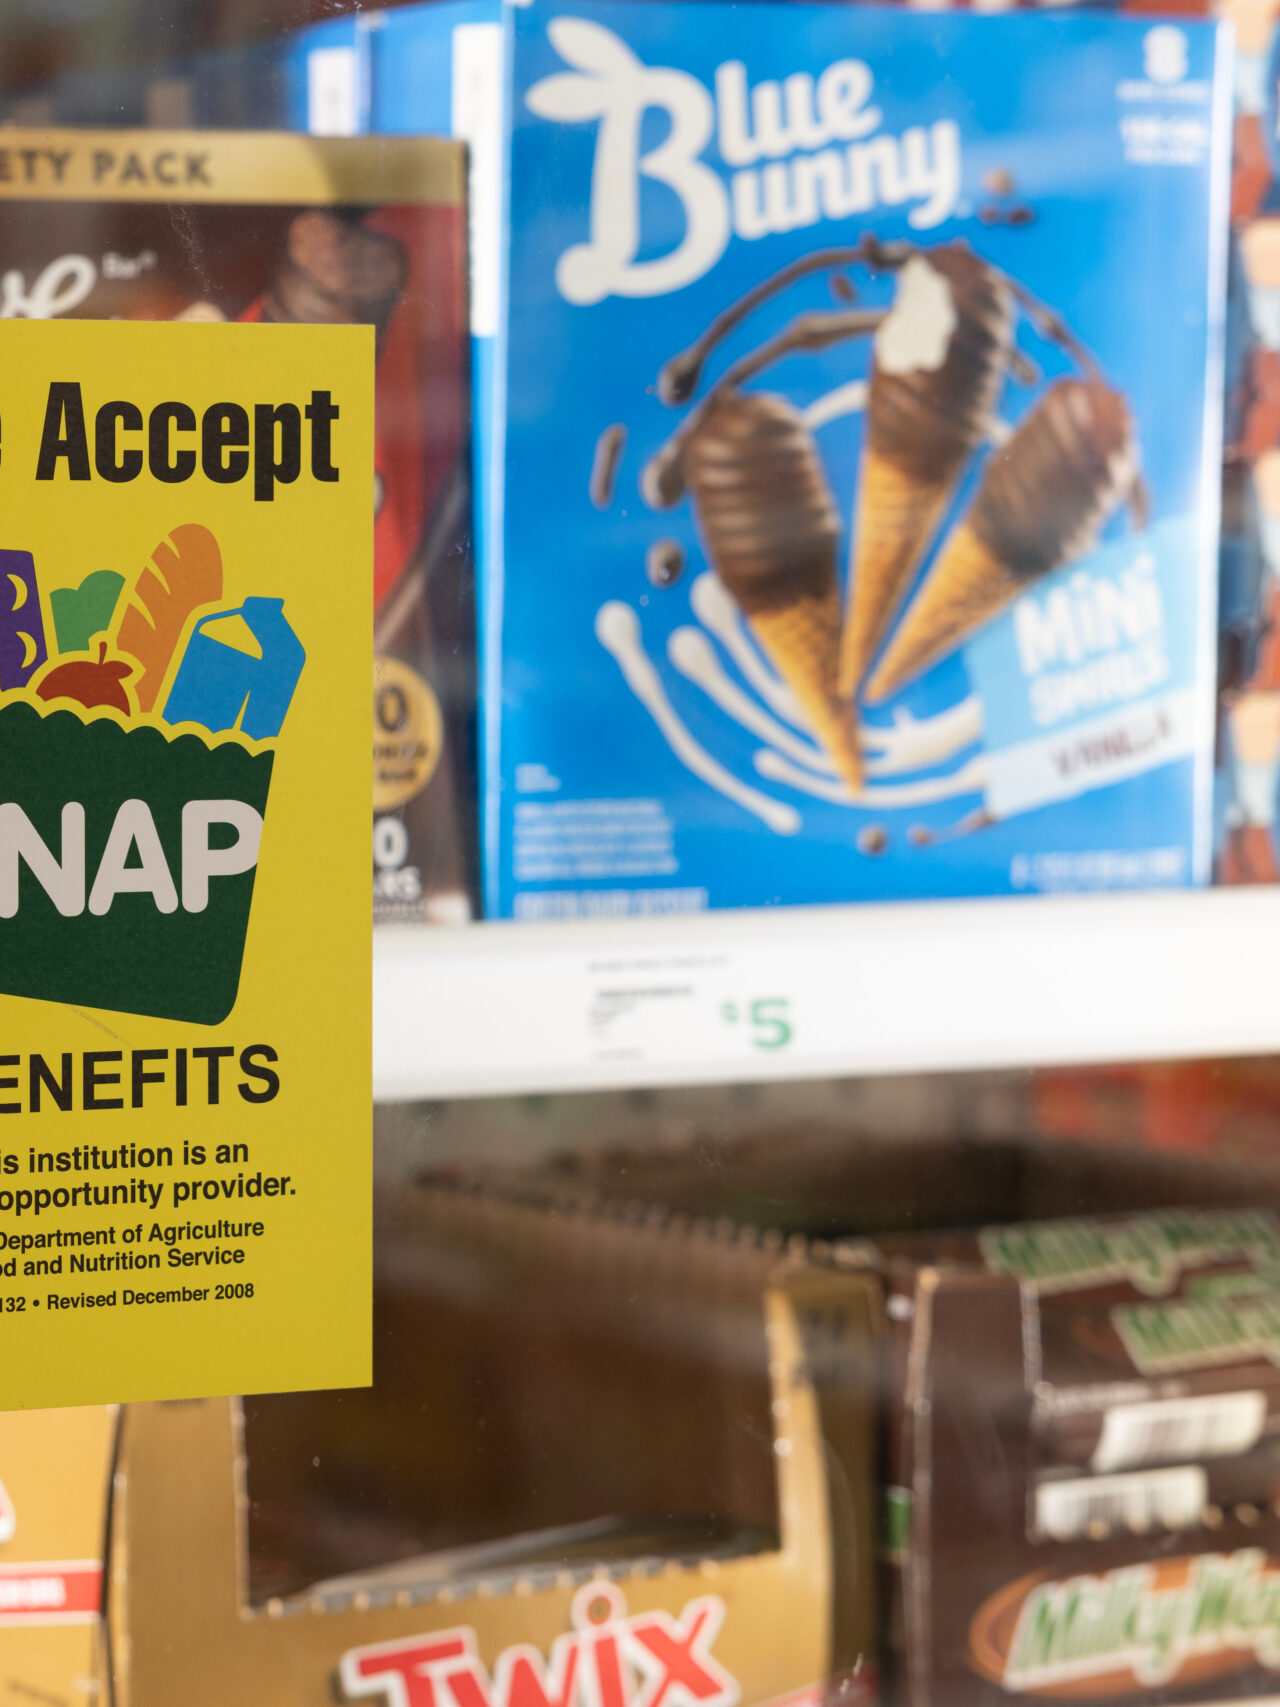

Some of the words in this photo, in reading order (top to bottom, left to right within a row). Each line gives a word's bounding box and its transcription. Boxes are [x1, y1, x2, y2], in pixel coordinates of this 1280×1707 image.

[92, 149, 212, 187] PACK
[35, 381, 340, 502] Accept
[29, 1142, 173, 1174] institution
[183, 1140, 207, 1166] is
[215, 1143, 249, 1164] an
[173, 1172, 296, 1208] provider.
[121, 1224, 143, 1244] of
[148, 1219, 265, 1247] Agriculture
[23, 1256, 63, 1276] and
[70, 1252, 161, 1274] Nutrition
[167, 1247, 245, 1268] Service
[46, 1290, 117, 1311] Revised
[122, 1287, 210, 1306] December
[214, 1282, 255, 1300] 2008
